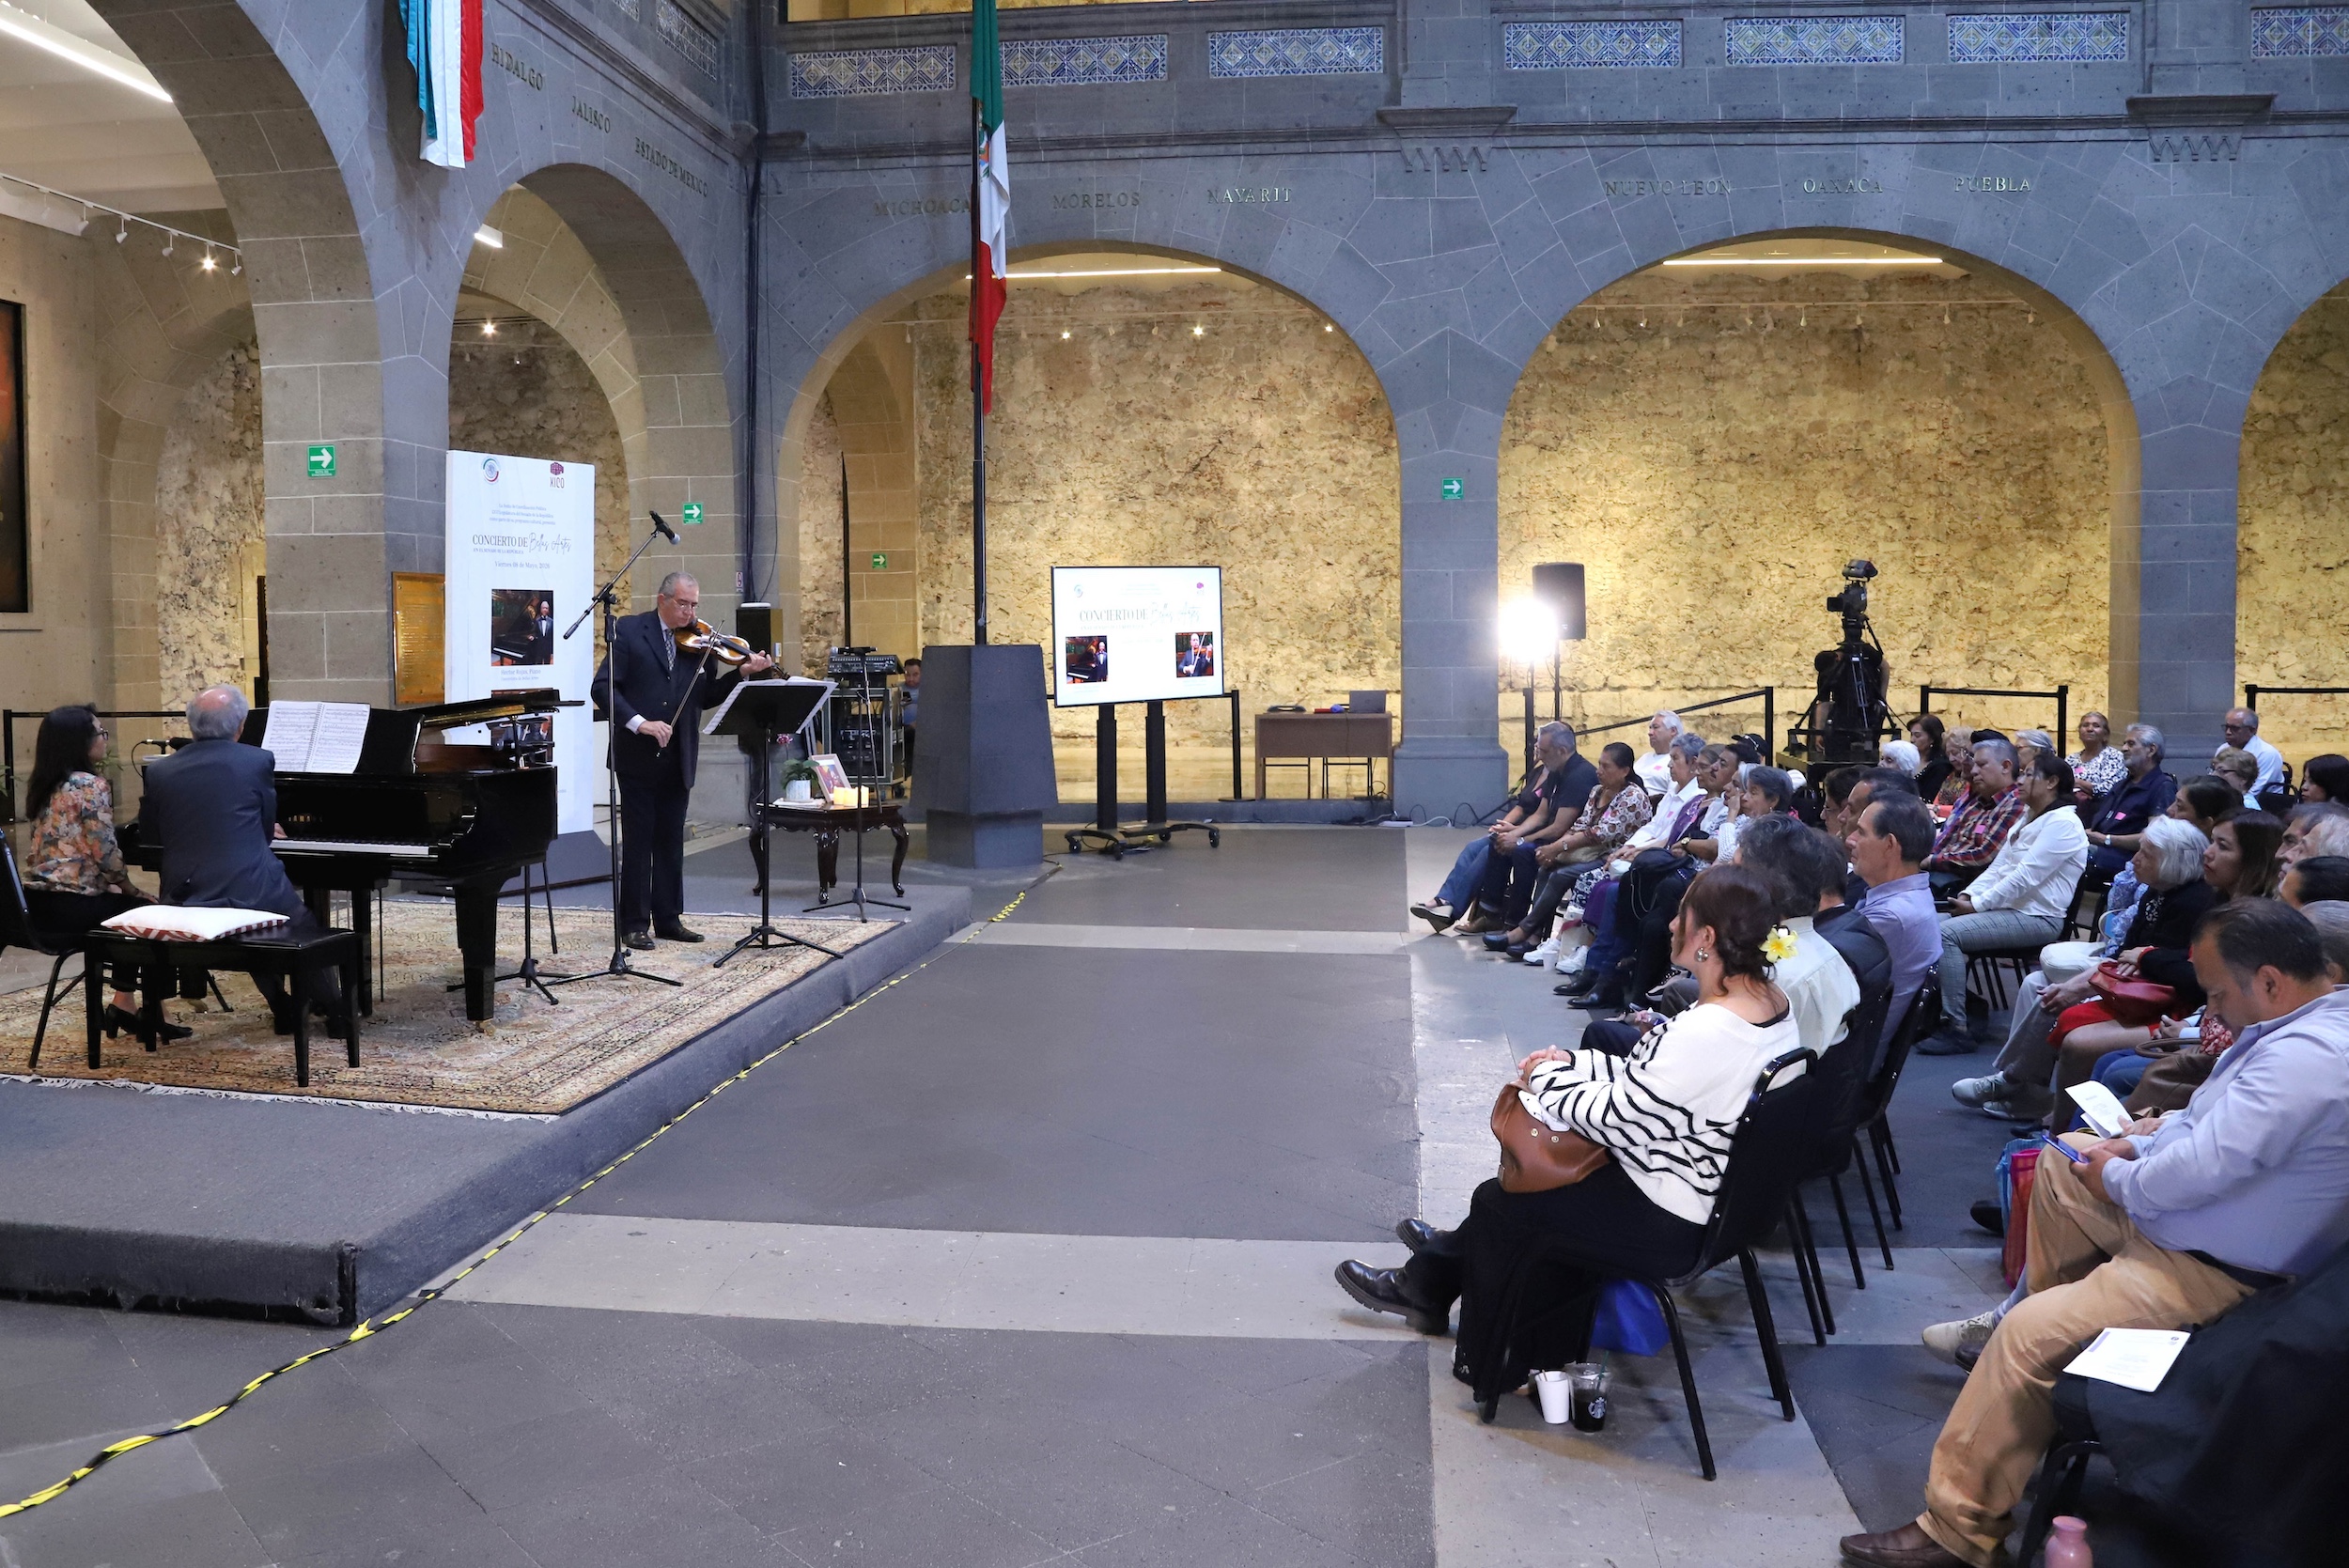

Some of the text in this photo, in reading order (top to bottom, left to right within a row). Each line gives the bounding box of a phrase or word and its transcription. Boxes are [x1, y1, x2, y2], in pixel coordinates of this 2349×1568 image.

[491, 42, 543, 91] HIDALGO
[571, 96, 611, 134] JALISCO
[635, 136, 668, 170] ESTADO
[668, 159, 677, 179] DE
[1605, 179, 1732, 196] NUEVO LEON
[1802, 179, 1883, 194] OAXACA
[1954, 177, 2032, 193] PUEBLA
[1053, 192, 1140, 210] MORELOS
[1207, 187, 1291, 204] NAYARIT
[873, 198, 971, 216] MICHOACA
[550, 476, 565, 489] XICO
[473, 534, 517, 547] CONCIERTO
[518, 536, 528, 548] DE
[1080, 609, 1134, 622] CONCIERTO
[1136, 608, 1148, 621] DE
